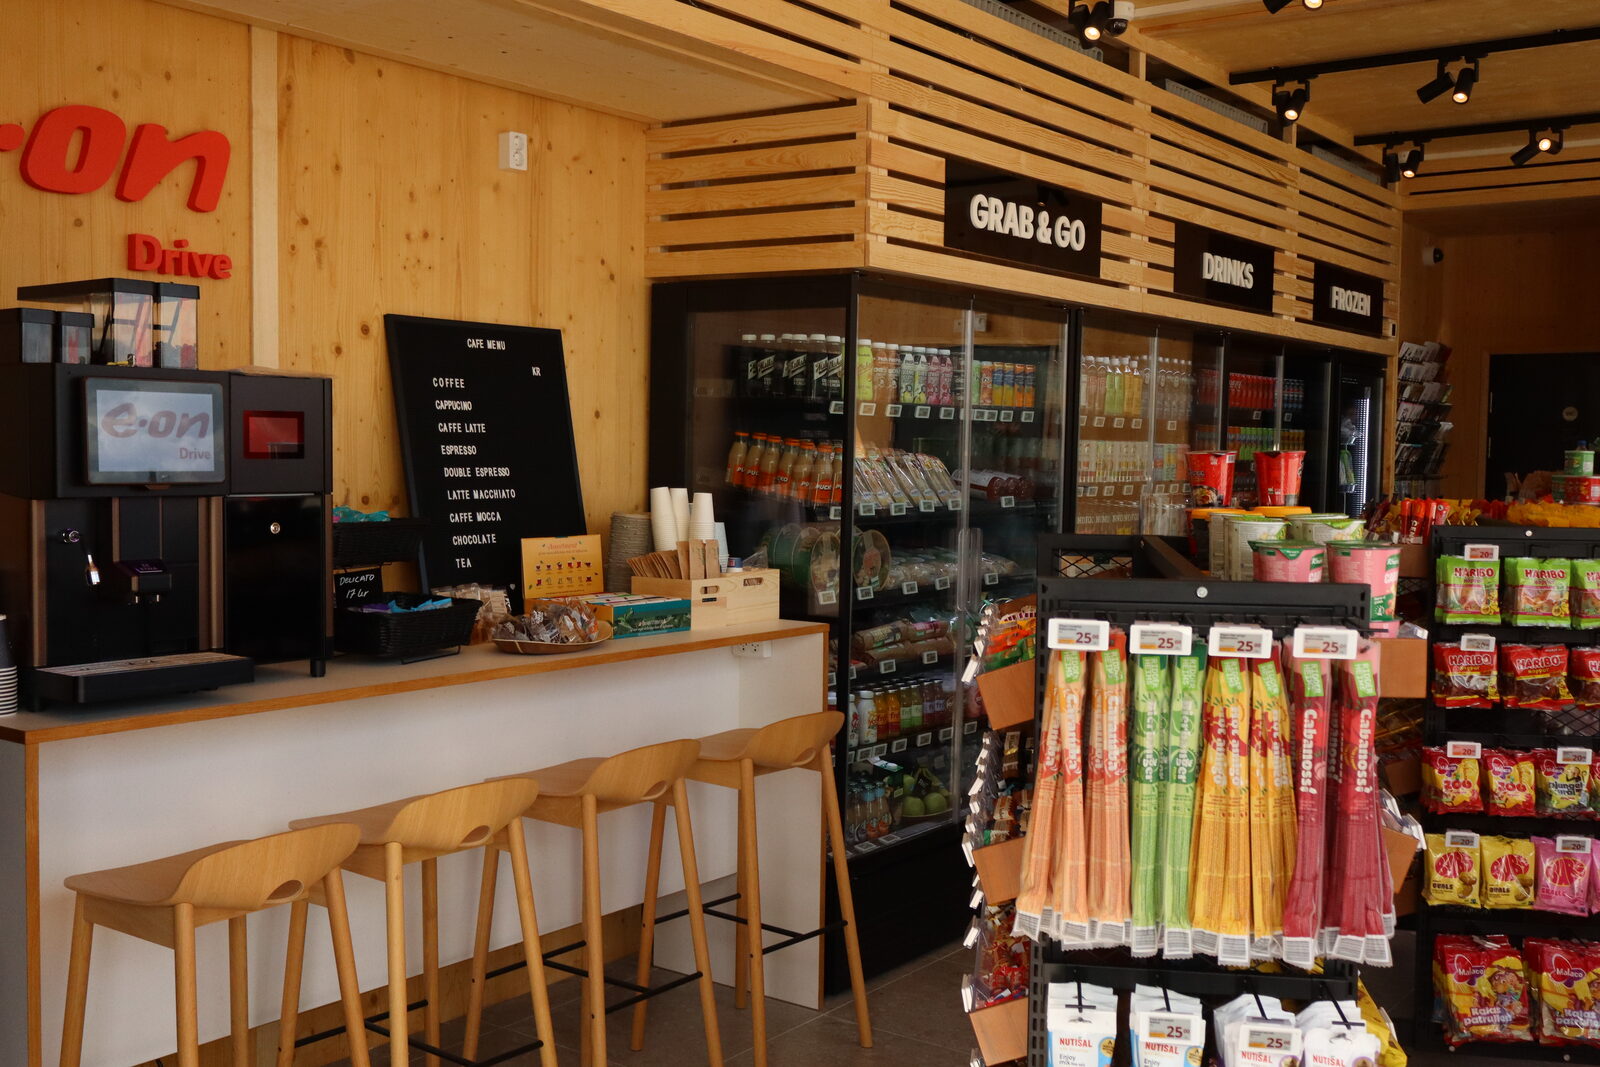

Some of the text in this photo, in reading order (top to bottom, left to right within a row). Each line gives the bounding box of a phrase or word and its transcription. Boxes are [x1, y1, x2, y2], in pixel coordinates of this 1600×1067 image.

[969, 192, 1087, 252] GRAB & GO
[127, 233, 233, 280] Drive
[1202, 251, 1255, 290] DRINKS
[1330, 285, 1372, 317] FROZEN
[467, 338, 506, 351] CAFE MENU
[532, 366, 541, 377] KR
[432, 377, 465, 389] COFFEE
[435, 399, 473, 411] CAPPUCINO
[438, 422, 486, 434] CAFFE LATTE
[179, 446, 211, 461] Drive
[441, 445, 477, 456] ESPRESSO
[444, 466, 510, 478] DOUBLE ESPRESSO
[447, 488, 516, 501] LATTE MACCHIATO
[449, 511, 502, 523] CAFFE MOCCA
[452, 534, 497, 546] CHOCOLATE
[455, 558, 472, 569] TEA
[1454, 567, 1495, 578] HARIBO
[1525, 569, 1566, 579] HARIBO
[340, 574, 375, 586] DELICATO
[346, 589, 356, 599] 17
[1076, 632, 1092, 644] 25
[1158, 637, 1174, 649] 25
[1237, 640, 1253, 652] 25
[1322, 641, 1339, 653] 25
[1449, 655, 1493, 666] HARIBO
[1516, 656, 1561, 670] HARIBO
[1443, 779, 1473, 790] ZOO
[1497, 782, 1527, 793] ZOO
[1458, 968, 1485, 976] Malaco
[1556, 968, 1583, 978] Malaco
[1471, 1007, 1501, 1016] Kalas
[1564, 1008, 1596, 1019] Kalas
[1166, 1025, 1183, 1038] 25
[1059, 1037, 1092, 1048] NUTISAL
[1145, 1042, 1179, 1055] NUTISAL
[1266, 1037, 1283, 1048] 25
[1059, 1053, 1076, 1063] Enjoy
[1241, 1051, 1273, 1063] NUTISAL
[1312, 1055, 1345, 1067] NUTISAL
